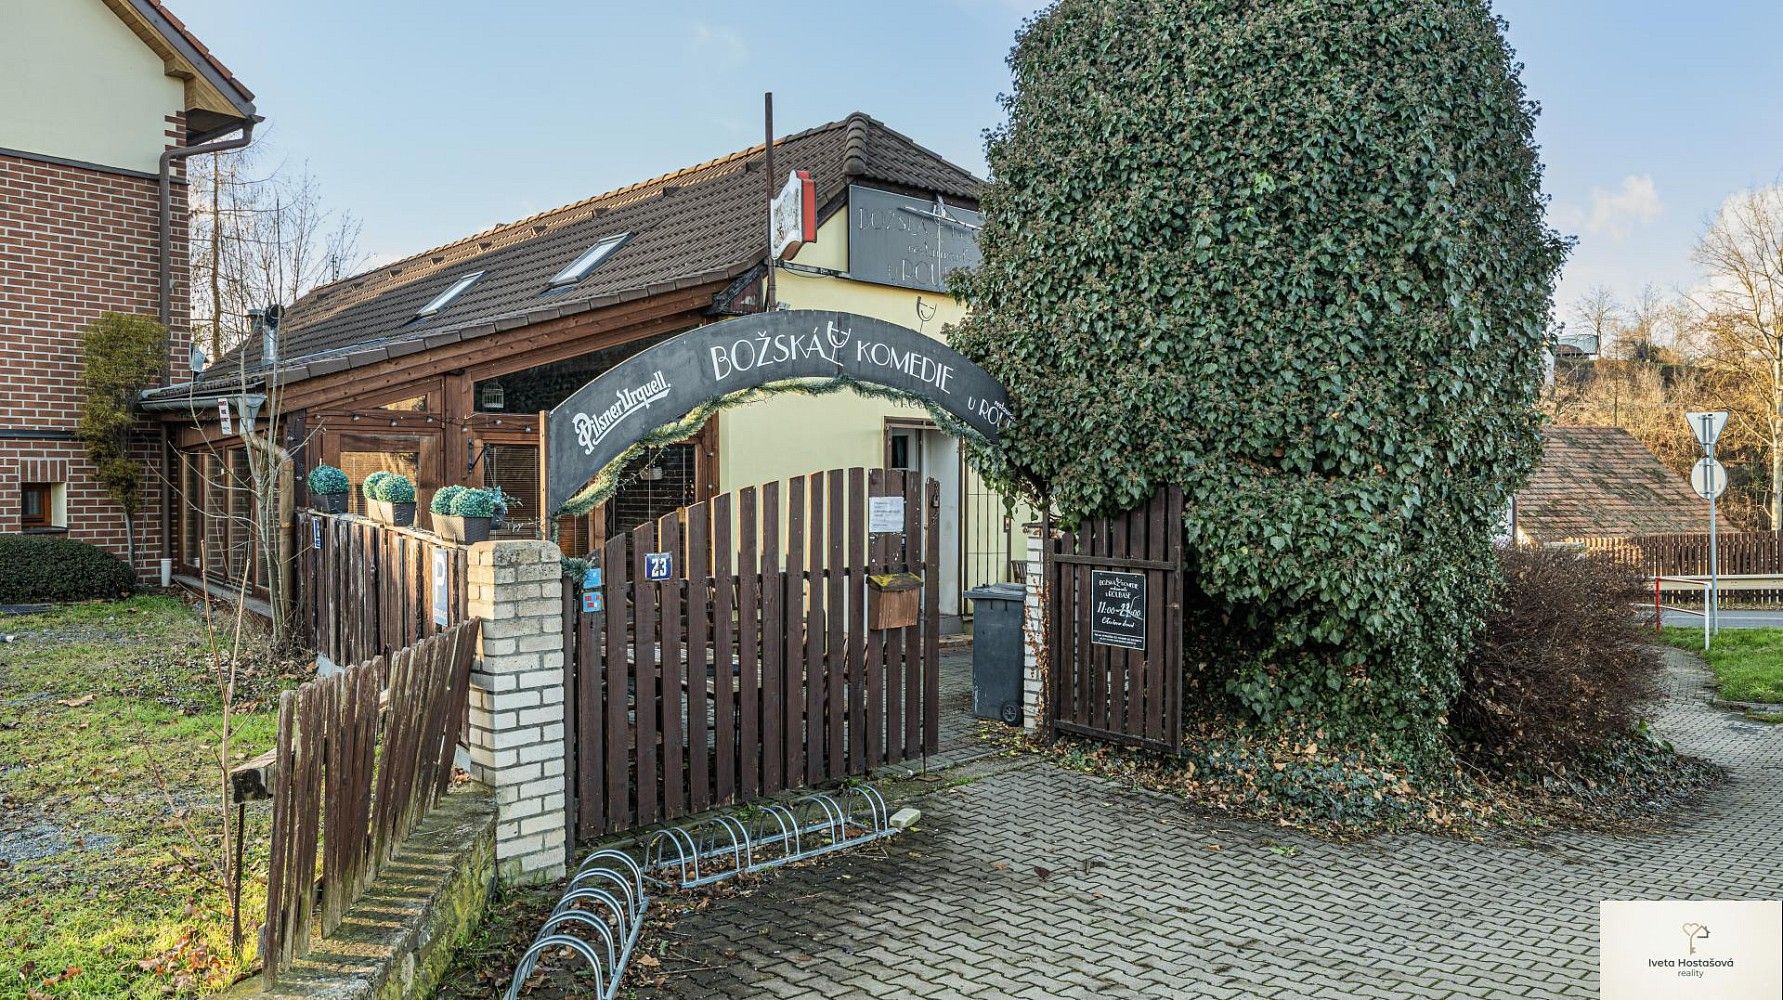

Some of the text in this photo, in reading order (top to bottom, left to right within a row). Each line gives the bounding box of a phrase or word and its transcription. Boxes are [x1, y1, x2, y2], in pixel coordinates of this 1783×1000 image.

[710, 327, 954, 394] BOŽSKÁ KOMEDIE
[572, 400, 624, 455] Pilsner
[434, 553, 446, 604] P
[651, 558, 667, 577] 23
